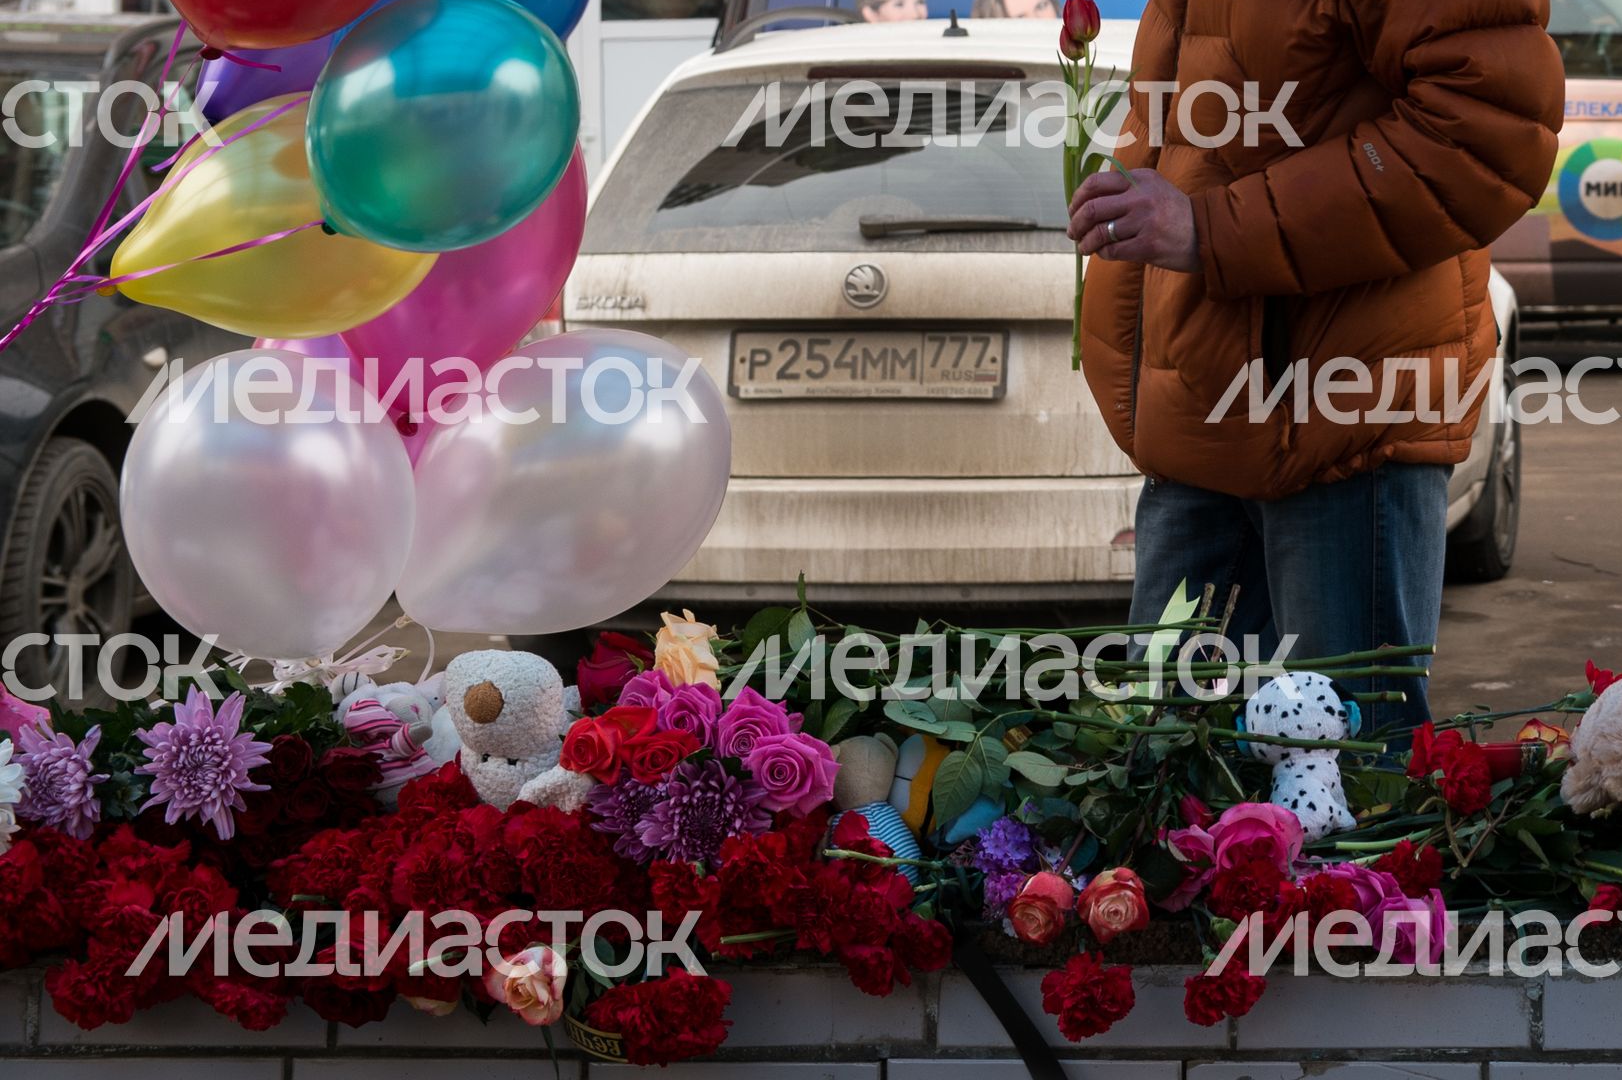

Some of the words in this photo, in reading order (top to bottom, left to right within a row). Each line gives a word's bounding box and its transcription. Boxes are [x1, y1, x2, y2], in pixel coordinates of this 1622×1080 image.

[748, 338, 918, 382] Р254ММ
[927, 335, 992, 369] 777
[940, 371, 975, 383] RUS
